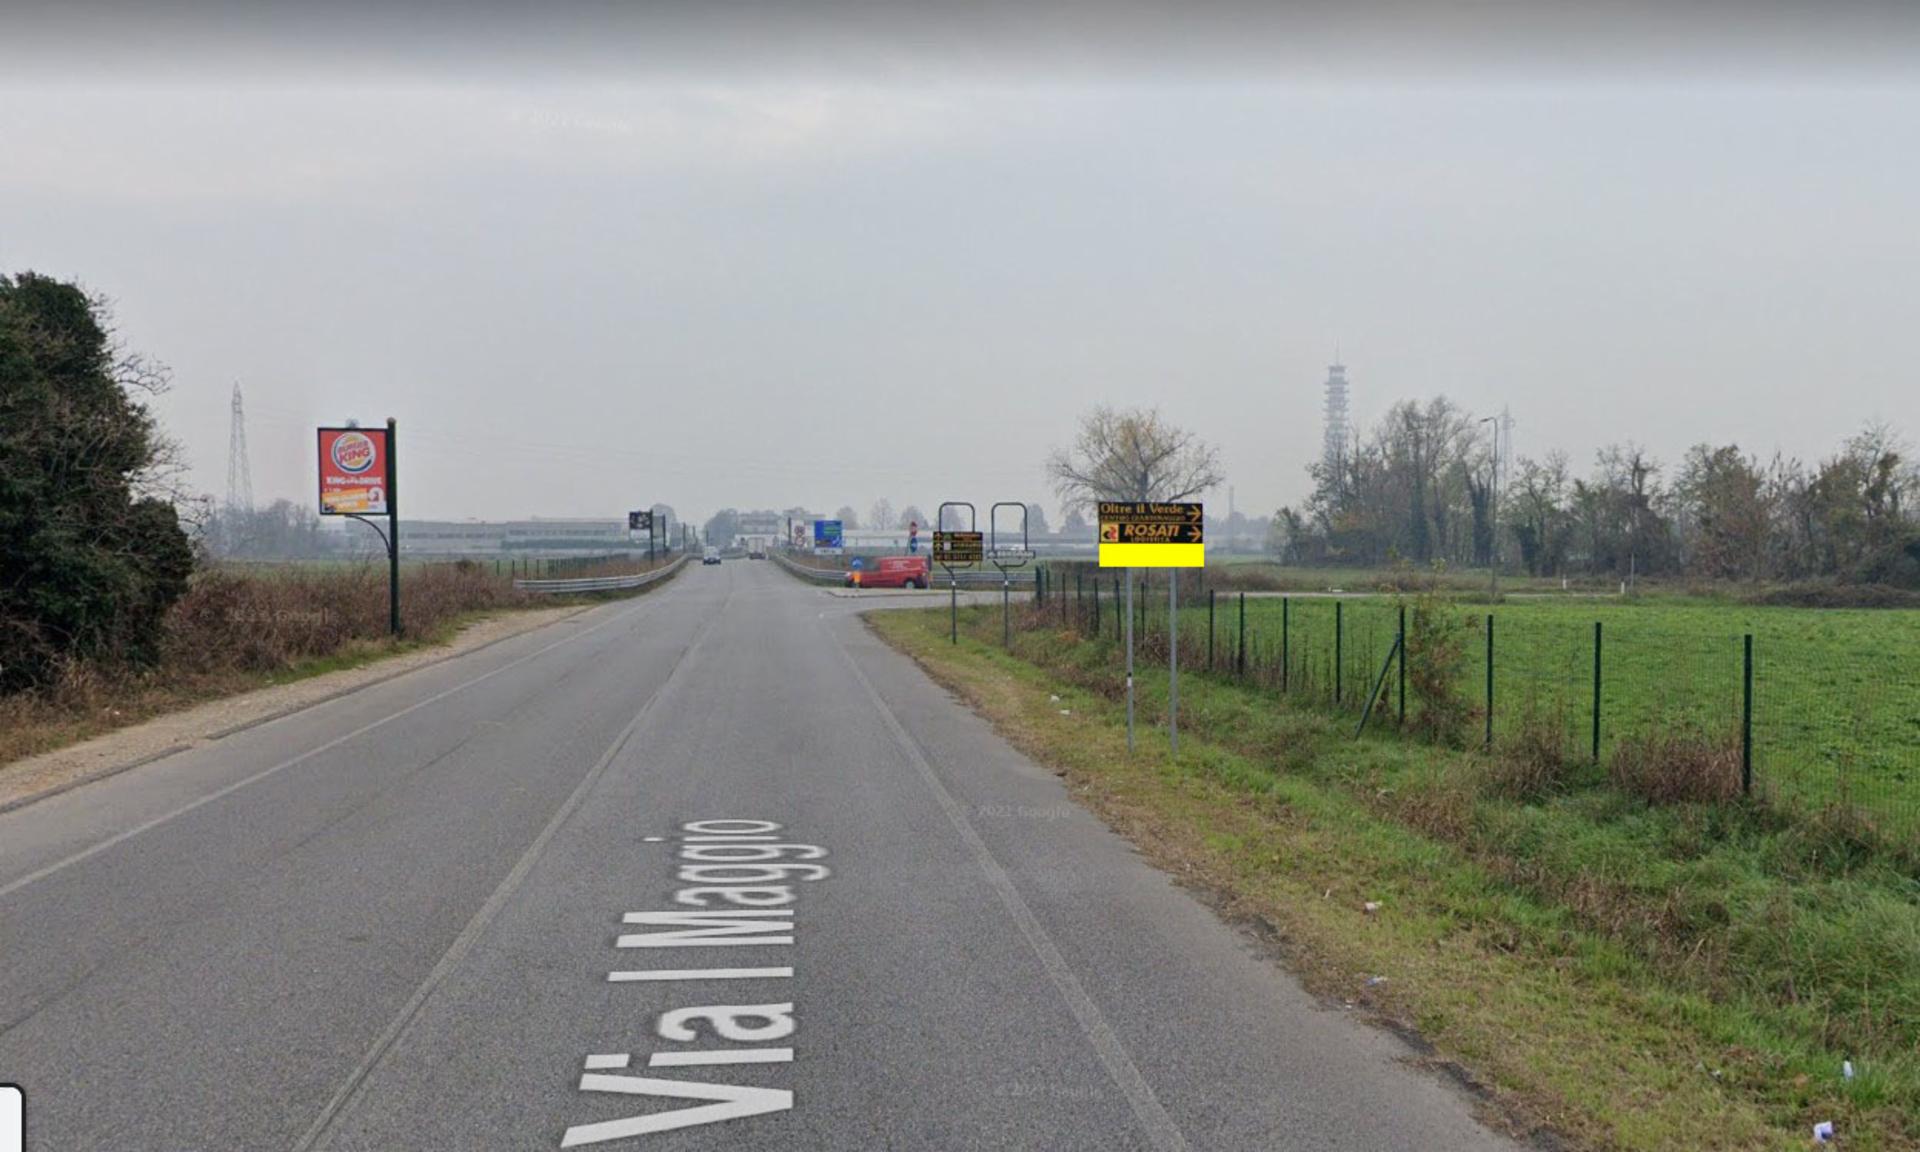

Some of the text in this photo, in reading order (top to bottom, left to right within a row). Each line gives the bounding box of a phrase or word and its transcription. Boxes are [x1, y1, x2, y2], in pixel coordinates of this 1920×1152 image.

[340, 447, 370, 463] KING
[1101, 503, 1132, 514] Oltre
[1149, 503, 1184, 514] Verde
[1124, 524, 1180, 537] ROSATI
